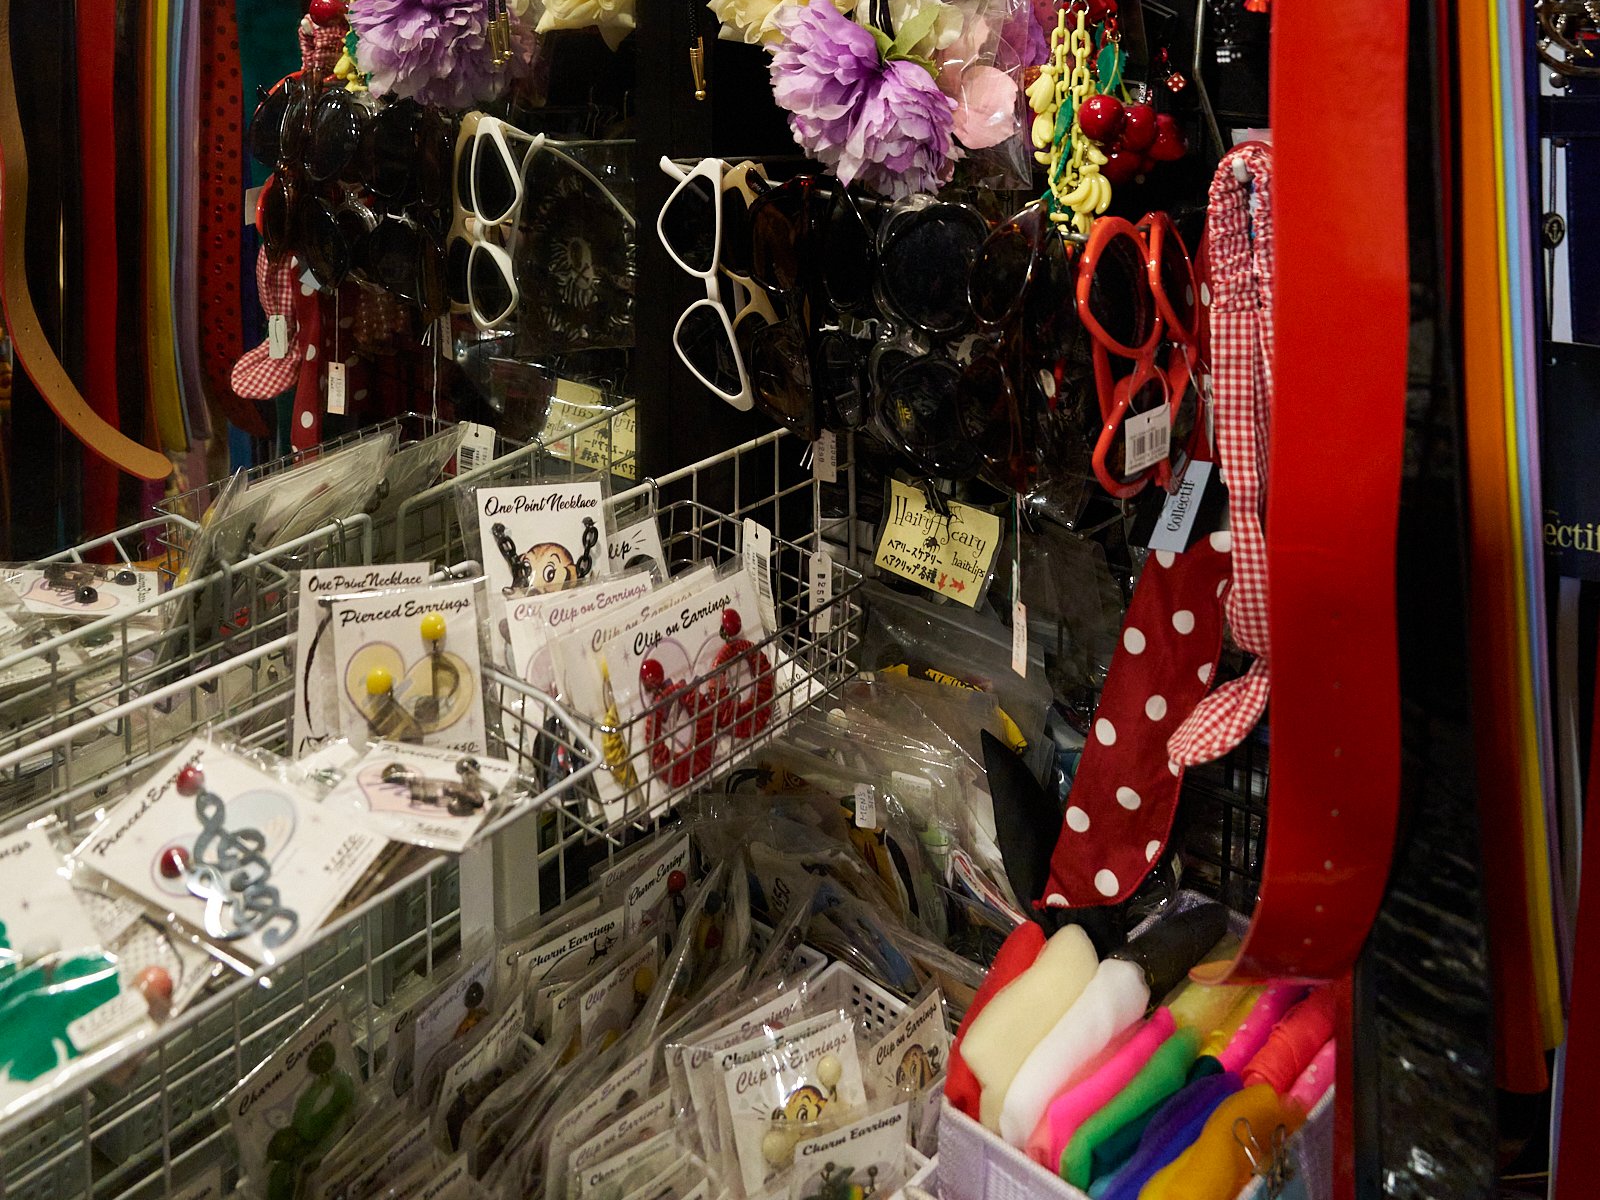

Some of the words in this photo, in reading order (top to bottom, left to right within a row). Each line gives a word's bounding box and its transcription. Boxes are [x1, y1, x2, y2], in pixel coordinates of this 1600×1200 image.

[484, 495, 514, 517] One
[513, 495, 546, 515] Point
[547, 493, 598, 512] Necklace
[1166, 479, 1195, 532] Collectif
[608, 540, 632, 560] lip
[308, 575, 332, 592] One
[333, 575, 367, 589] Point
[365, 571, 423, 587] Necklace
[339, 604, 401, 627] Pierced
[404, 597, 471, 618] Earrings
[549, 608, 578, 627] Clip
[580, 604, 596, 614] on
[595, 582, 648, 609] Earrings
[633, 631, 664, 656] Clip
[665, 623, 680, 638] on
[680, 593, 732, 629] Earrings
[528, 945, 567, 970] Charm
[568, 921, 616, 950] Earrings
[876, 1043, 896, 1066] Clip
[895, 1035, 906, 1047] on
[905, 1003, 937, 1039] Earrings
[735, 1070, 770, 1095] Clip
[790, 1034, 848, 1070] Earrings
[802, 1136, 848, 1156] Charm
[849, 1113, 902, 1141] Earrings
